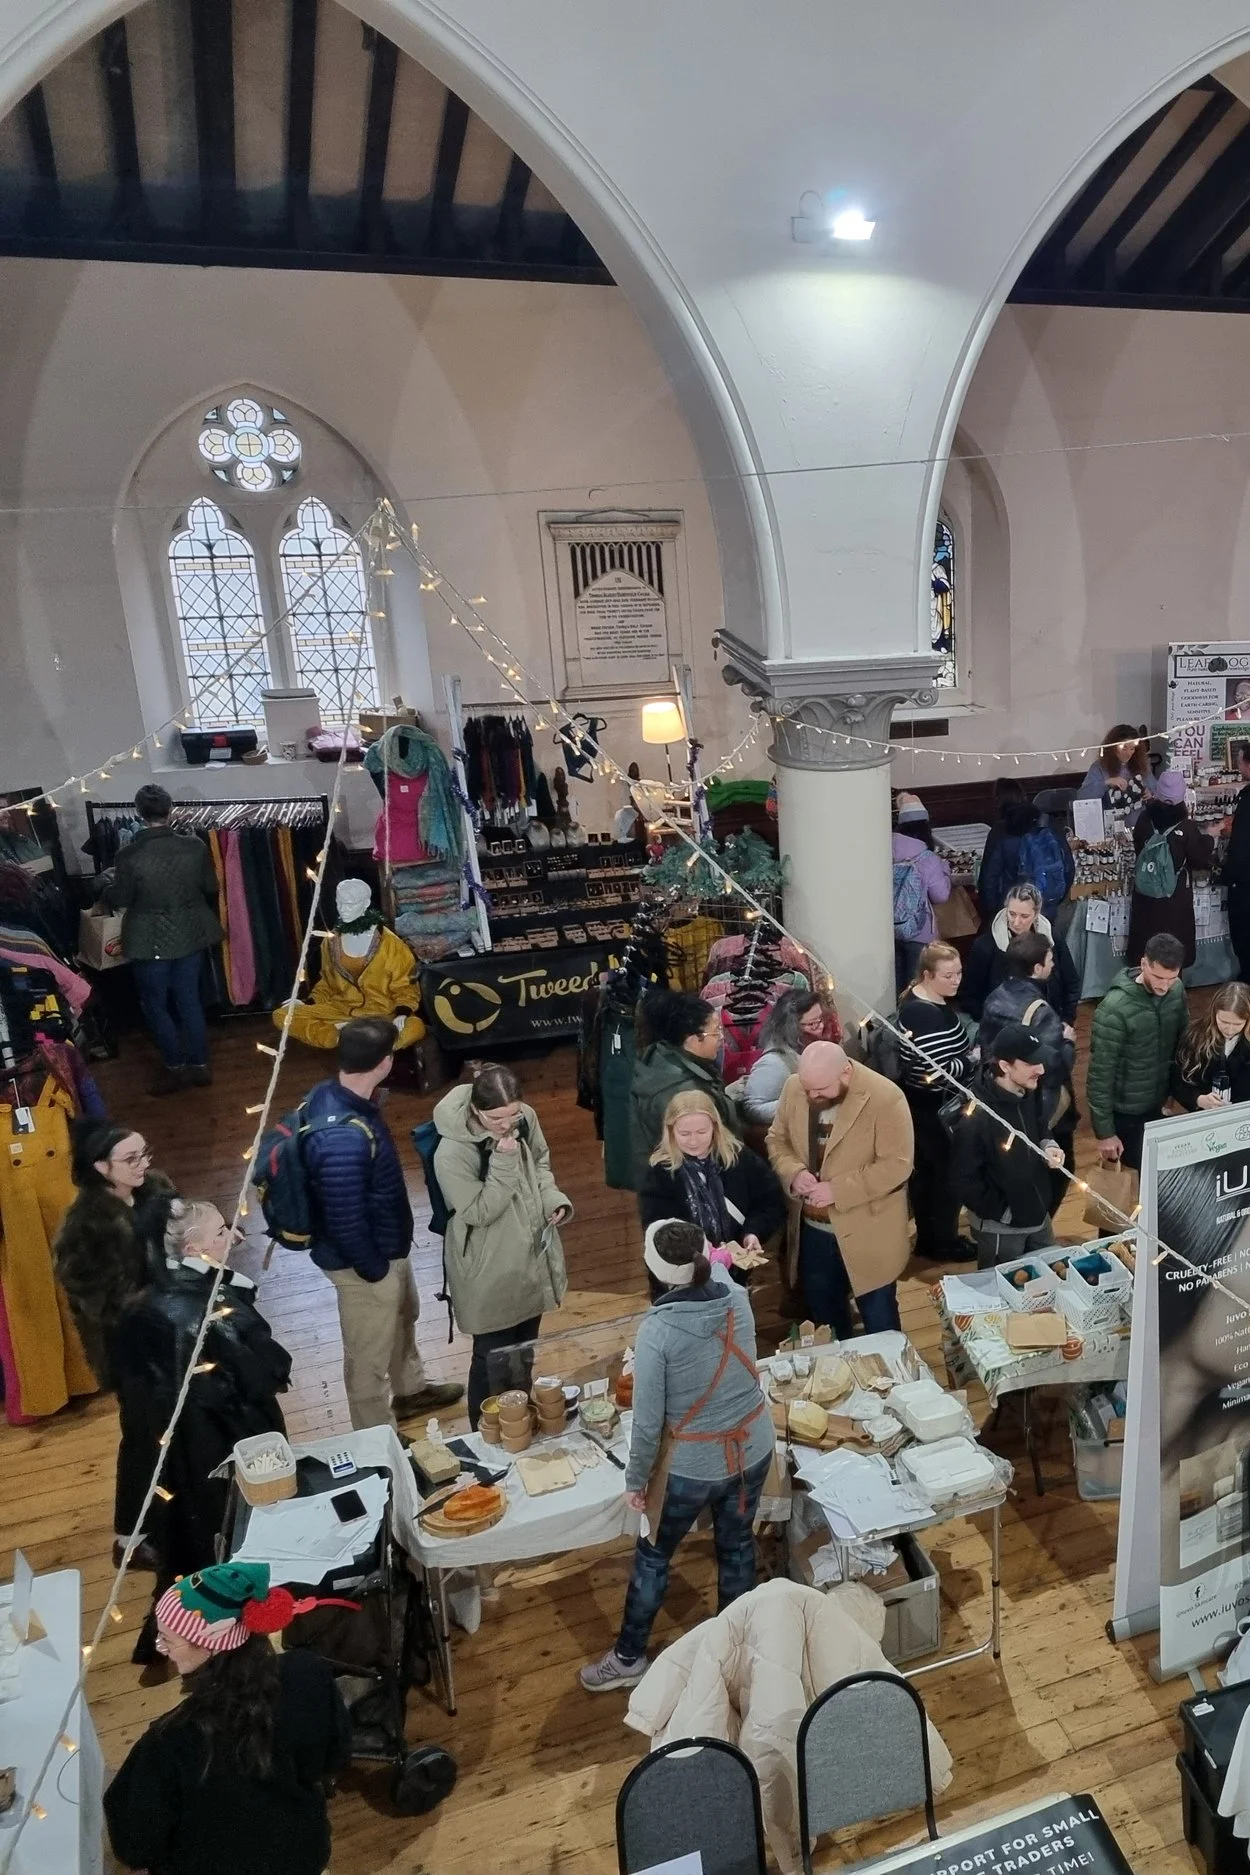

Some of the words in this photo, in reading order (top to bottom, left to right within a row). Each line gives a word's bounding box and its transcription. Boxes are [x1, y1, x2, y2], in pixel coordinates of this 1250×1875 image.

[1174, 738, 1204, 748] CAN
[1174, 750, 1203, 760] FEEL
[1206, 1141, 1228, 1154] Vegan
[1216, 1210, 1236, 1225] NATURAL
[1236, 1210, 1241, 1218] &
[1166, 1254, 1233, 1280] CRUELTY-FREE
[1178, 1278, 1194, 1292] NO
[1196, 1266, 1238, 1289] PARABENS
[1226, 1310, 1247, 1324] Iuvo
[1215, 1332, 1234, 1346] 100%
[1234, 1362, 1248, 1372] Eco
[1227, 1376, 1250, 1390] Vegan
[1001, 1833, 1038, 1856] FOR
[1042, 1809, 1099, 1838] SMALL
[992, 1836, 1075, 1875] TRADERS
[1047, 1851, 1095, 1875] TIME!
